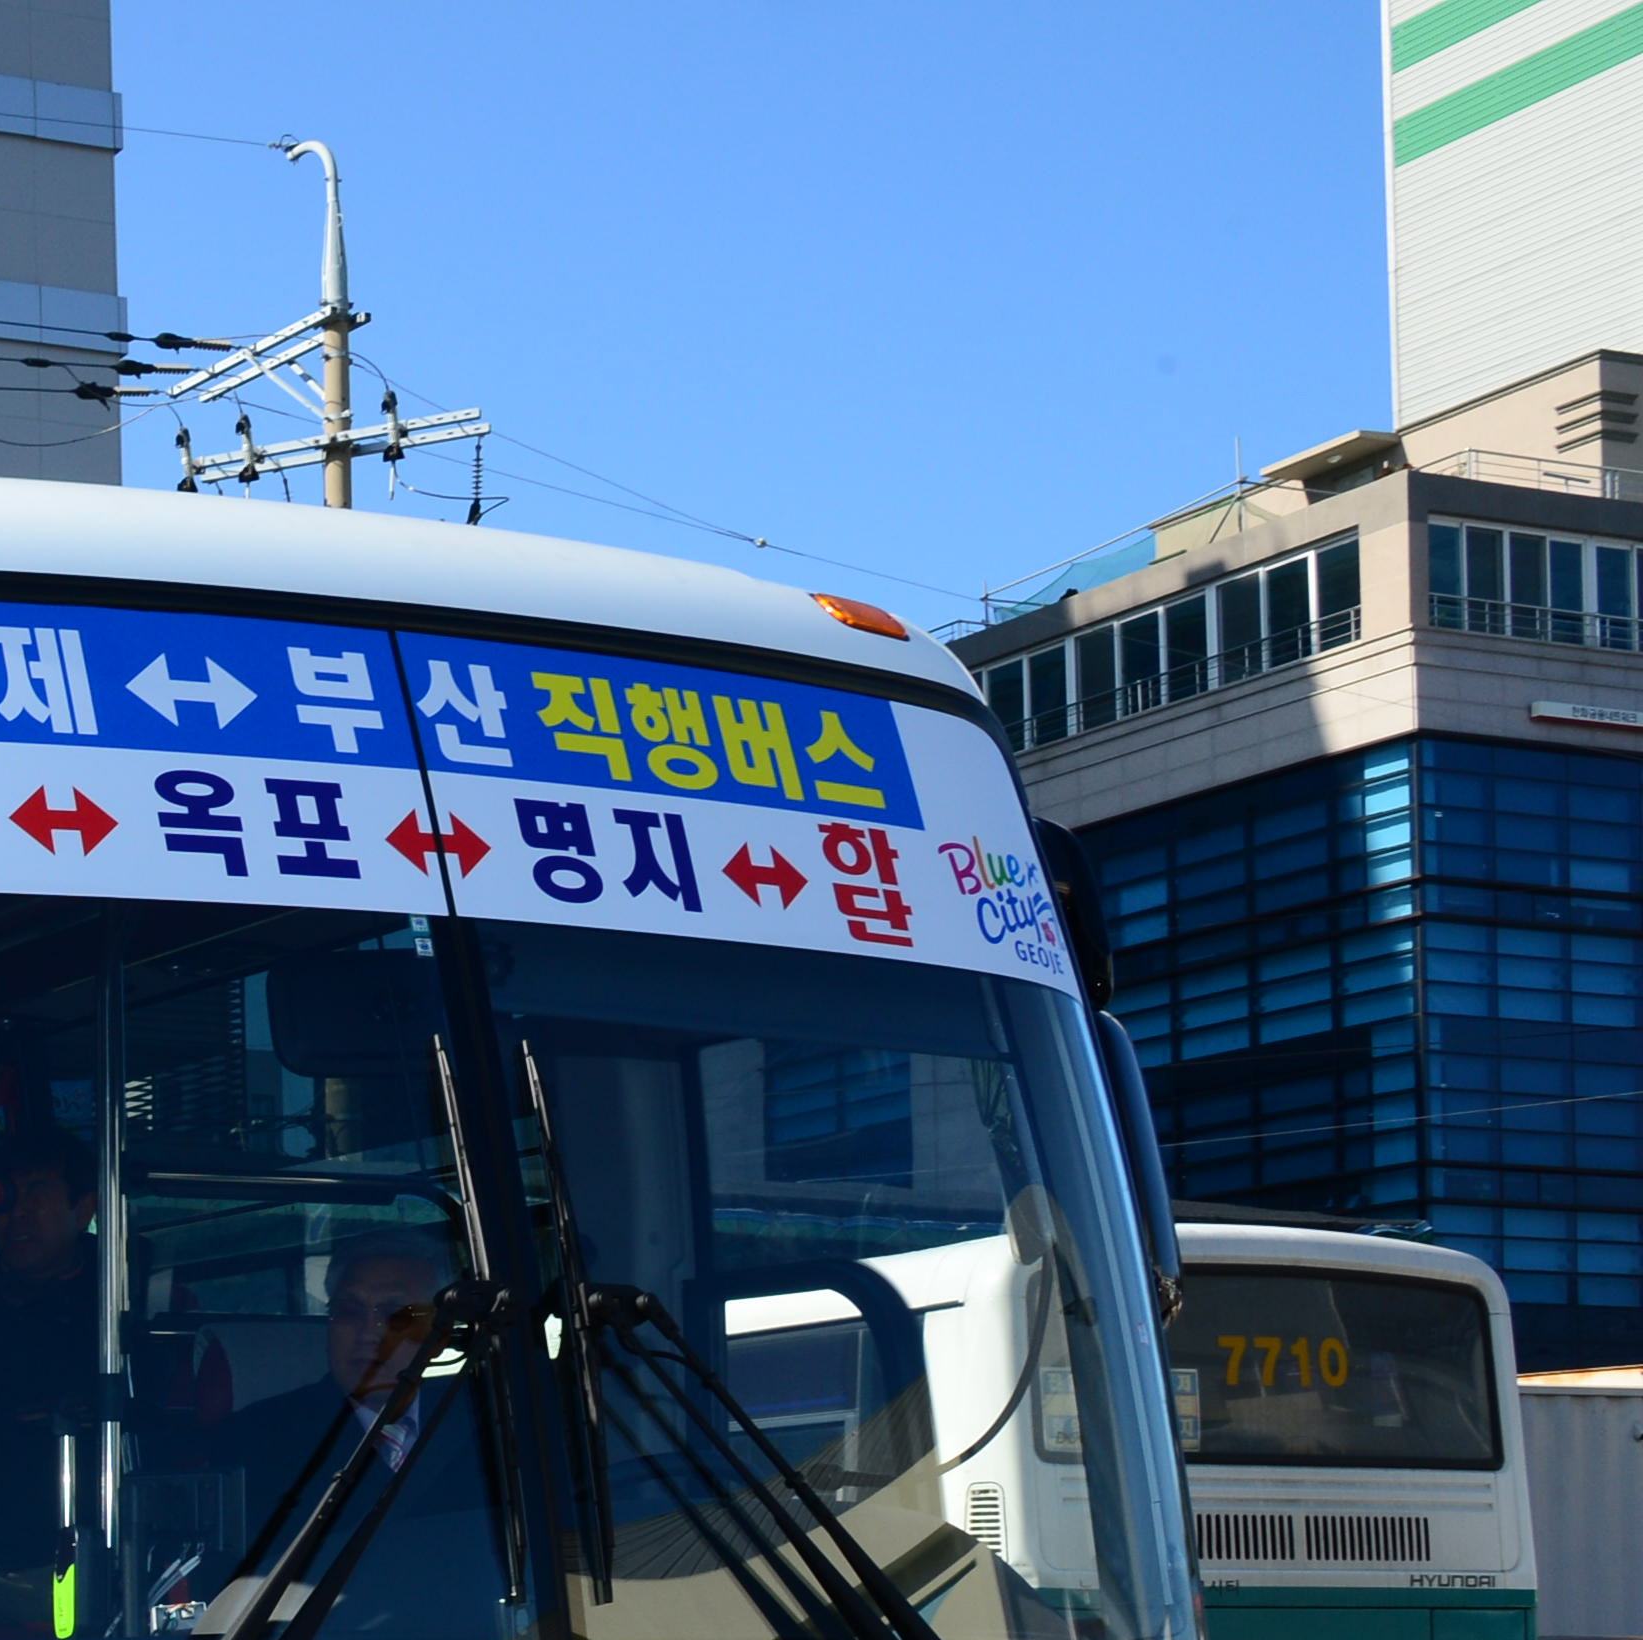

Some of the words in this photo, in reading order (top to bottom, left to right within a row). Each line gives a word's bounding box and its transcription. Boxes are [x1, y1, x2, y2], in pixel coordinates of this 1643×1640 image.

[286, 645, 514, 768] 부산
[529, 670, 887, 810] 직행버스
[154, 768, 363, 880] 옥포
[513, 796, 704, 913] 명지
[817, 820, 914, 948] 하단
[937, 835, 1026, 895] Blue
[976, 888, 1043, 945] City
[1014, 940, 1064, 976] GEOJE
[1218, 1335, 1350, 1388] 7710
[1409, 1574, 1497, 1588] HYUNDAI
